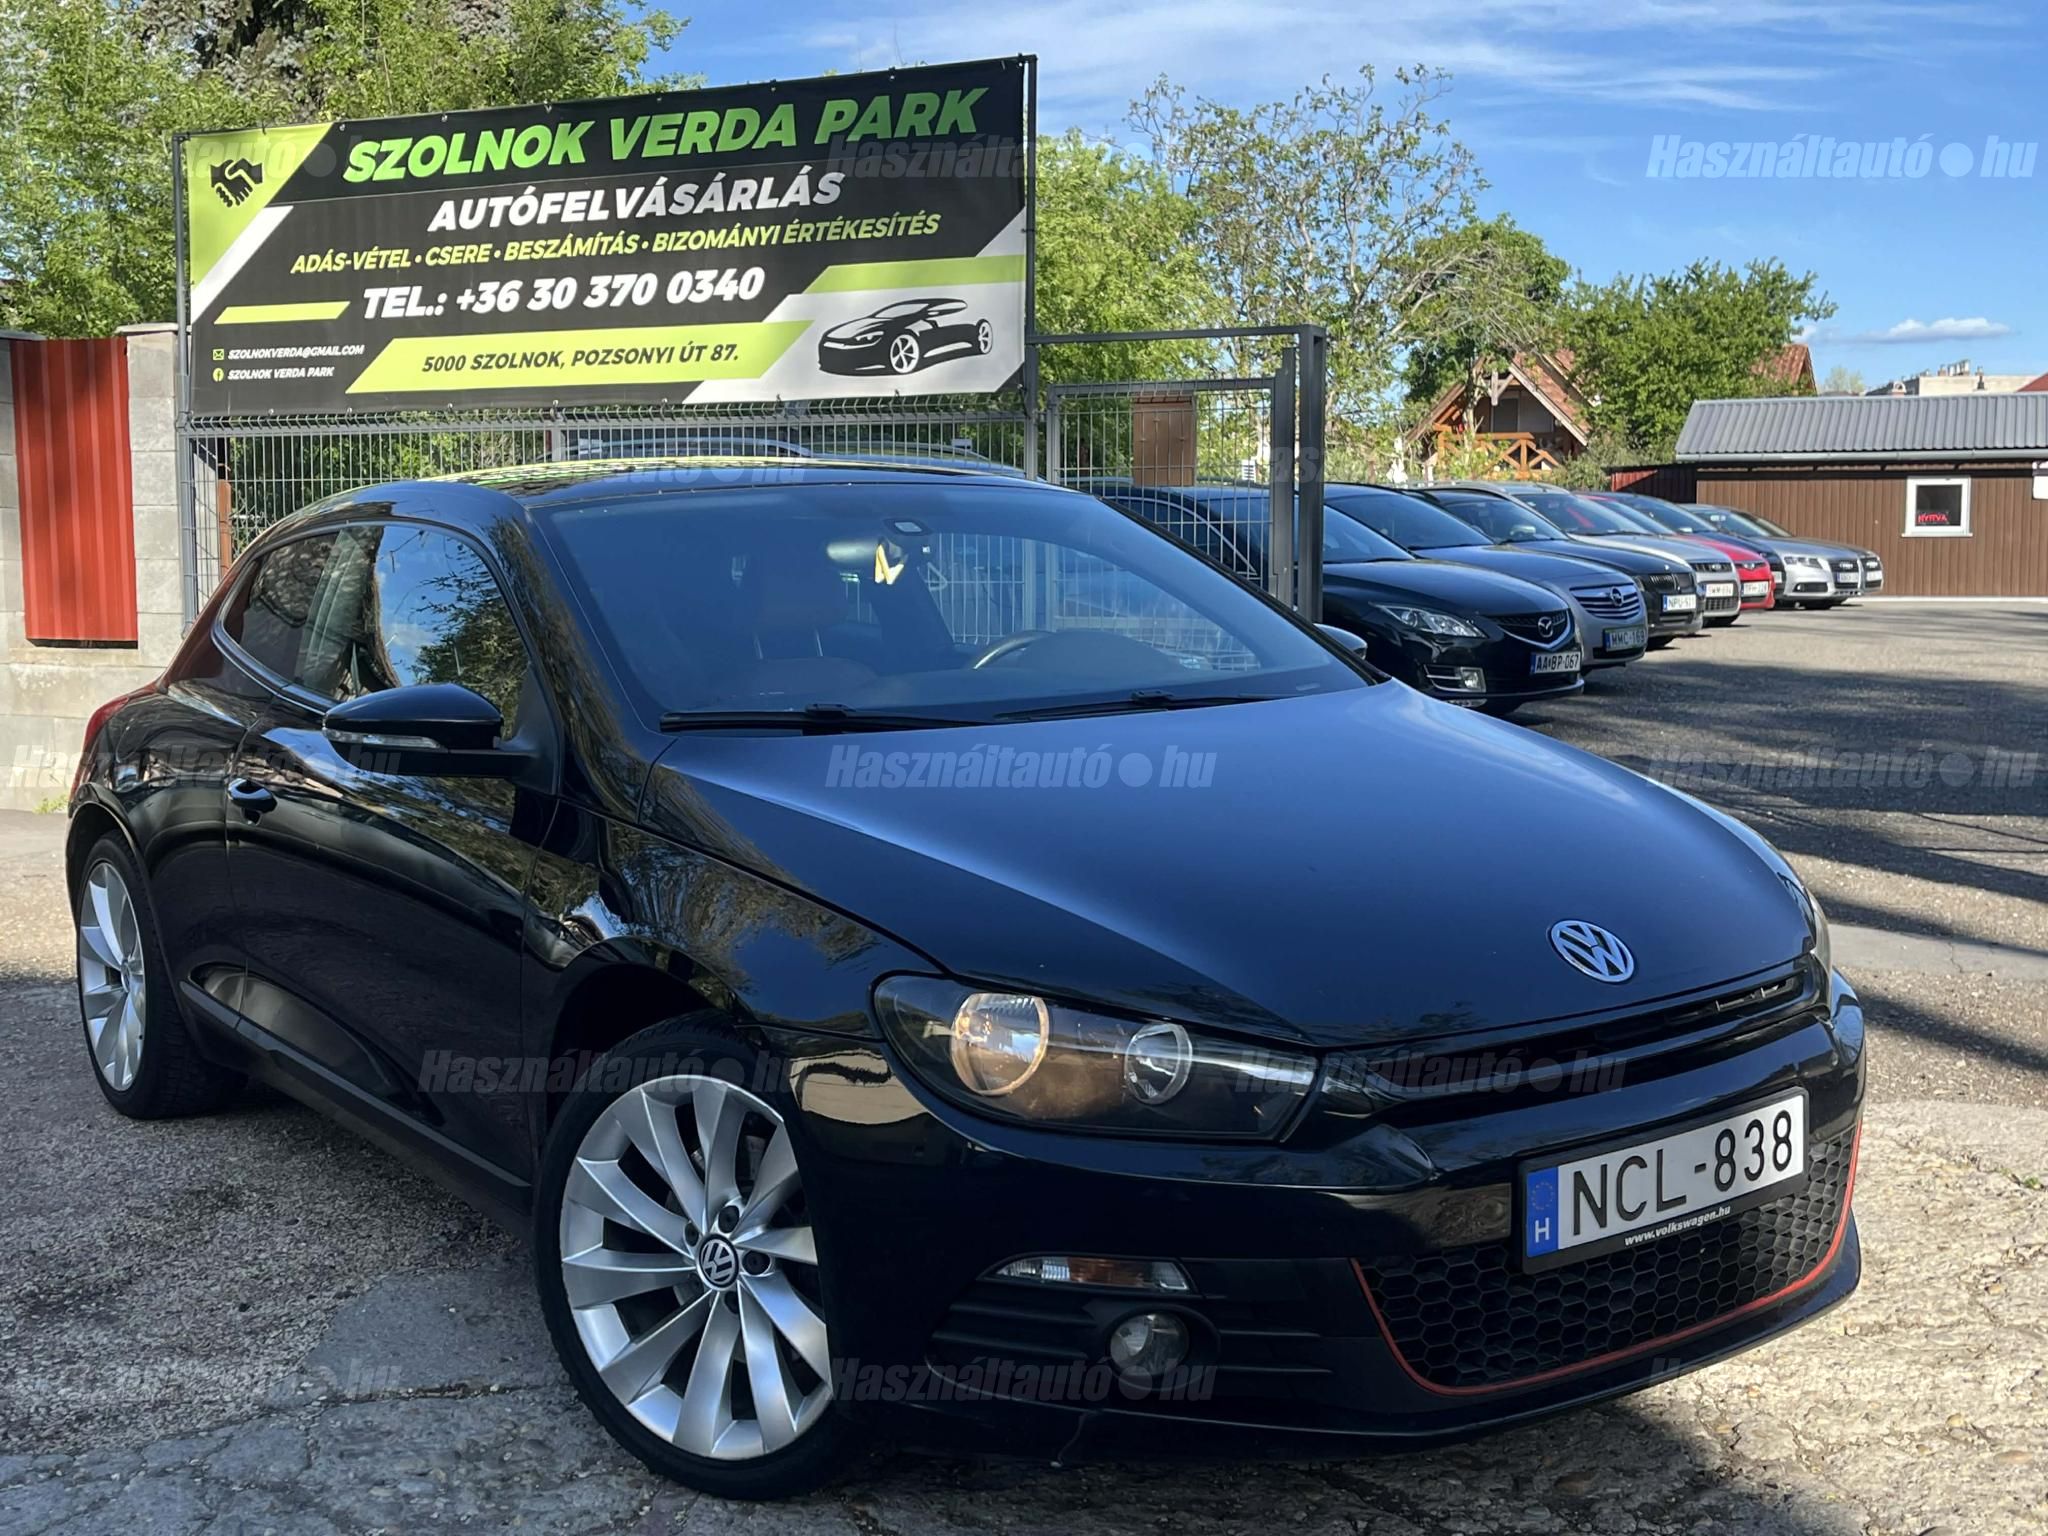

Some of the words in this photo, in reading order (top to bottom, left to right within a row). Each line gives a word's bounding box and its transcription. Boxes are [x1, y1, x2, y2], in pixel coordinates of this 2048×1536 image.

[343, 118, 596, 184] SZOLNOK
[609, 103, 797, 161] VERDA
[814, 87, 990, 146] PARK
[427, 165, 846, 232] AUTÓFELVÁSÁRLÁS
[290, 246, 412, 275] ADÁS-VÉTEL
[424, 247, 490, 267] CSERE
[504, 230, 639, 261] BESZÁMÍTÁS
[651, 222, 781, 254] BIZOMÁNYI
[783, 208, 942, 245] ÉRTÉKESÍTÉS
[362, 286, 445, 320] TEL.:
[455, 280, 522, 314] +36
[527, 277, 577, 312] 30
[583, 272, 658, 309] 370
[666, 266, 766, 304] 0340
[228, 344, 366, 360] SZOLNOKVERDA@GMAIL.COM
[228, 369, 272, 380] SZOLNOK
[274, 367, 306, 379] VERDA
[307, 366, 335, 378] PARK
[421, 355, 467, 374] 5000
[469, 351, 565, 371] SZOLNOK,
[570, 346, 676, 367] POZSONYI
[679, 341, 707, 363] ÚT
[710, 343, 739, 362] 87.
[1571, 1109, 1793, 1237] NCL-838
[1624, 1204, 1732, 1248] www.volkswagen.hu
